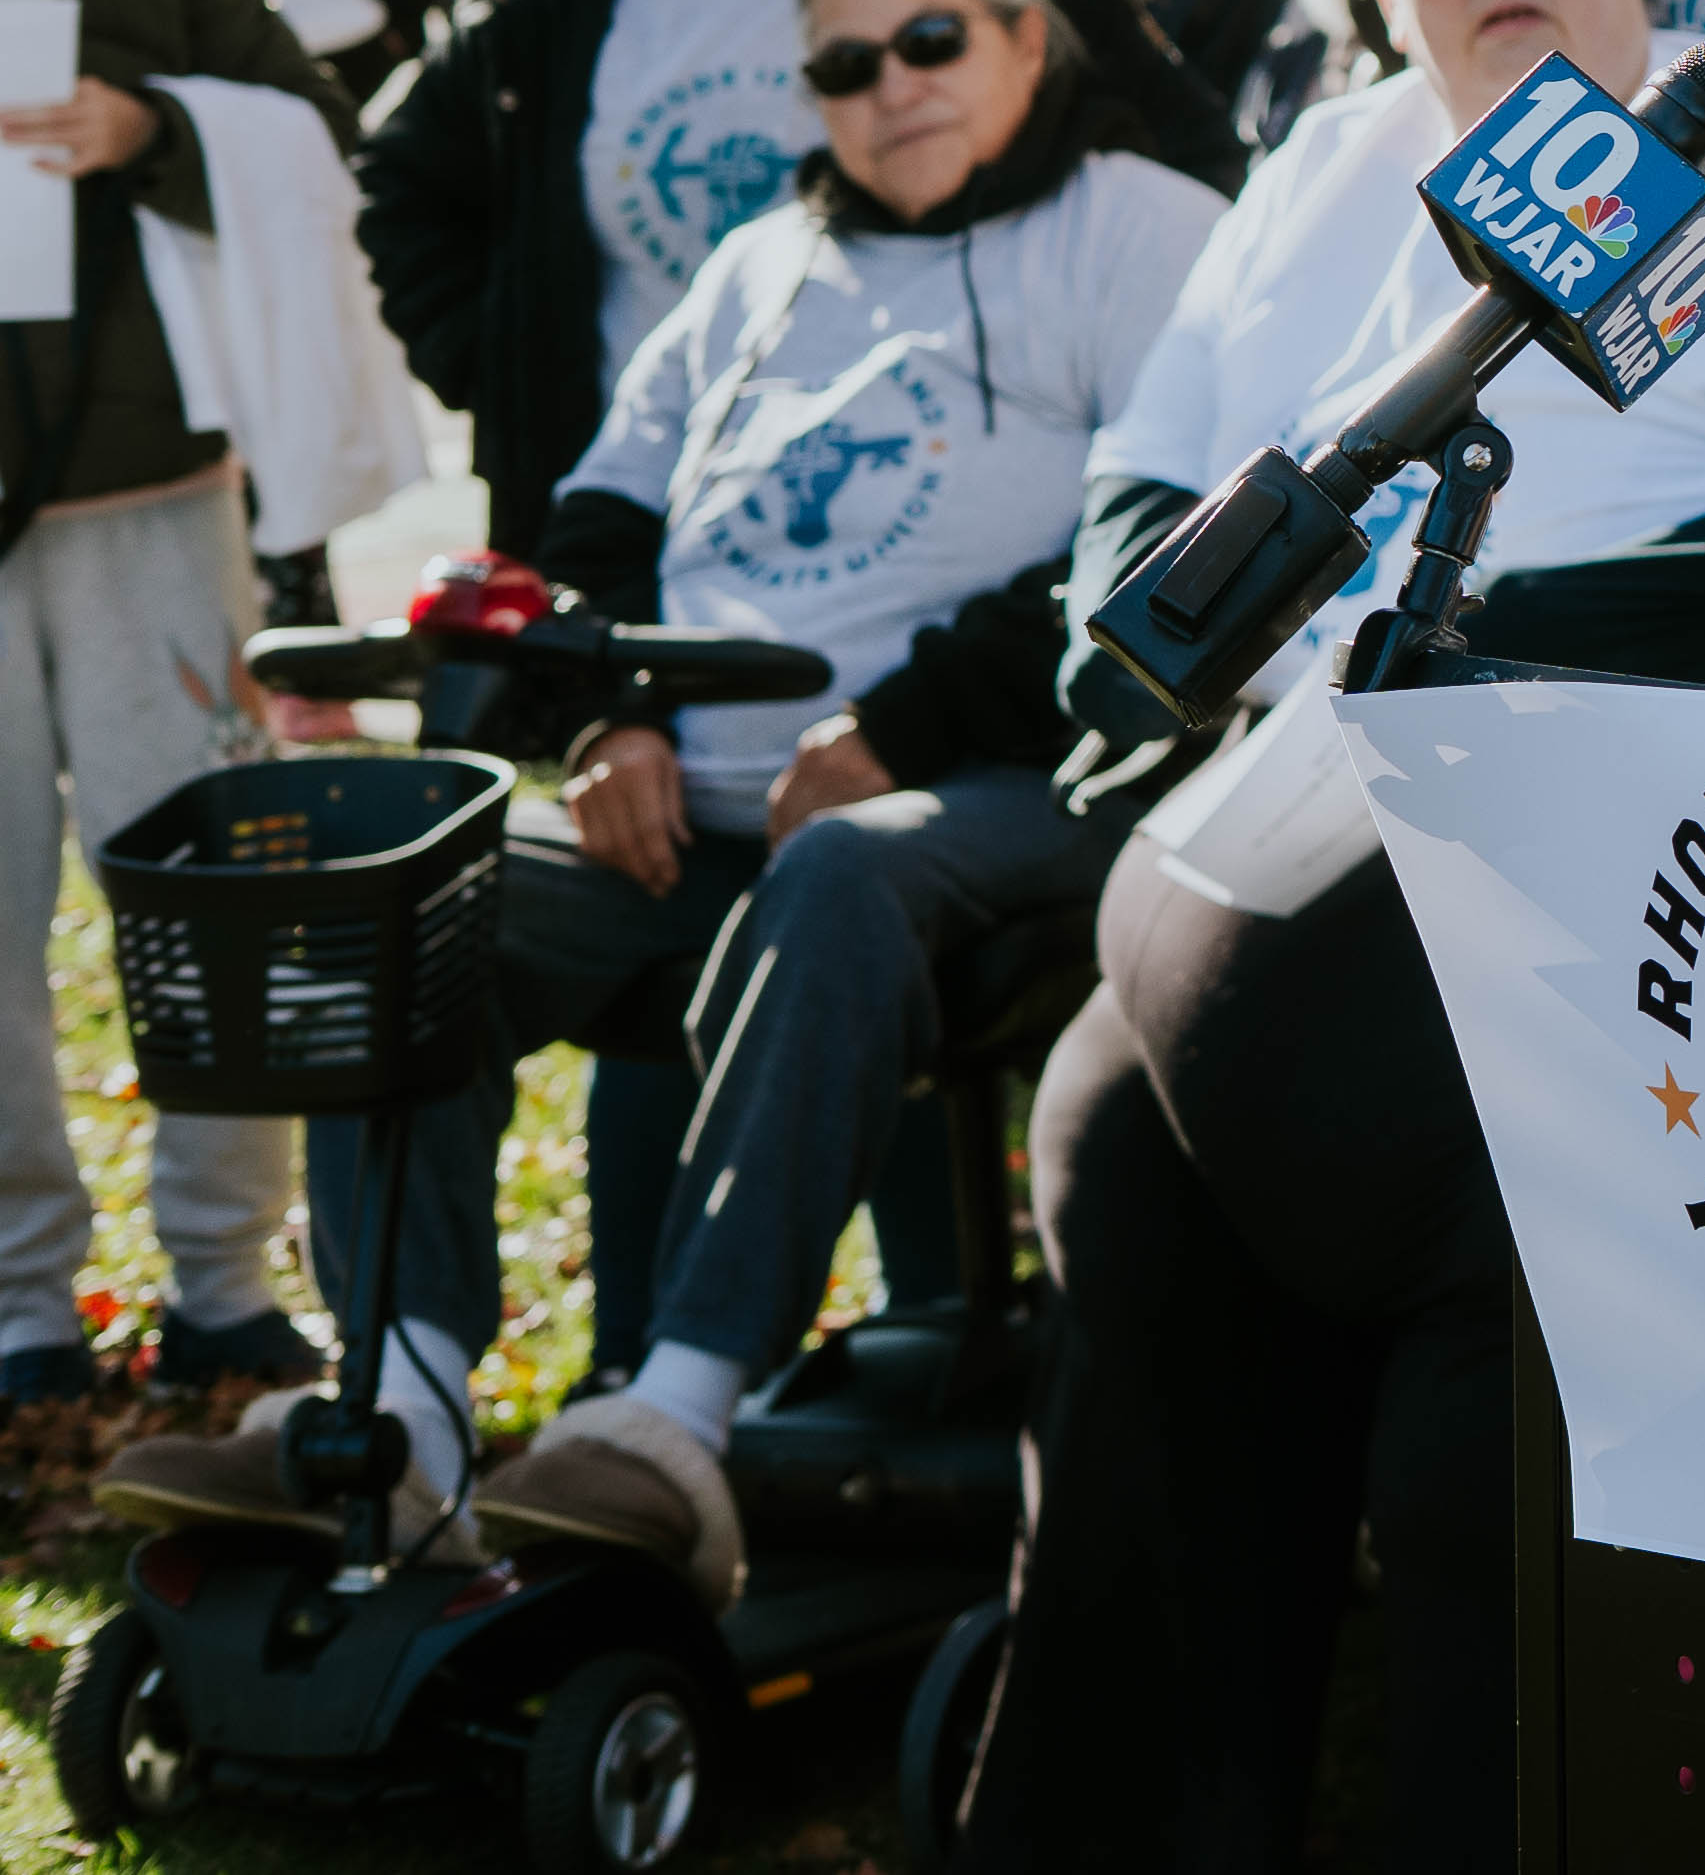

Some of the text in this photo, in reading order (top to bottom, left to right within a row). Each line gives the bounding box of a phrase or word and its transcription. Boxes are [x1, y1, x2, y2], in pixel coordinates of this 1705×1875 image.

[1488, 77, 1640, 214] 10
[1453, 158, 1597, 299] WJAR
[1596, 293, 1661, 395] WJAR
